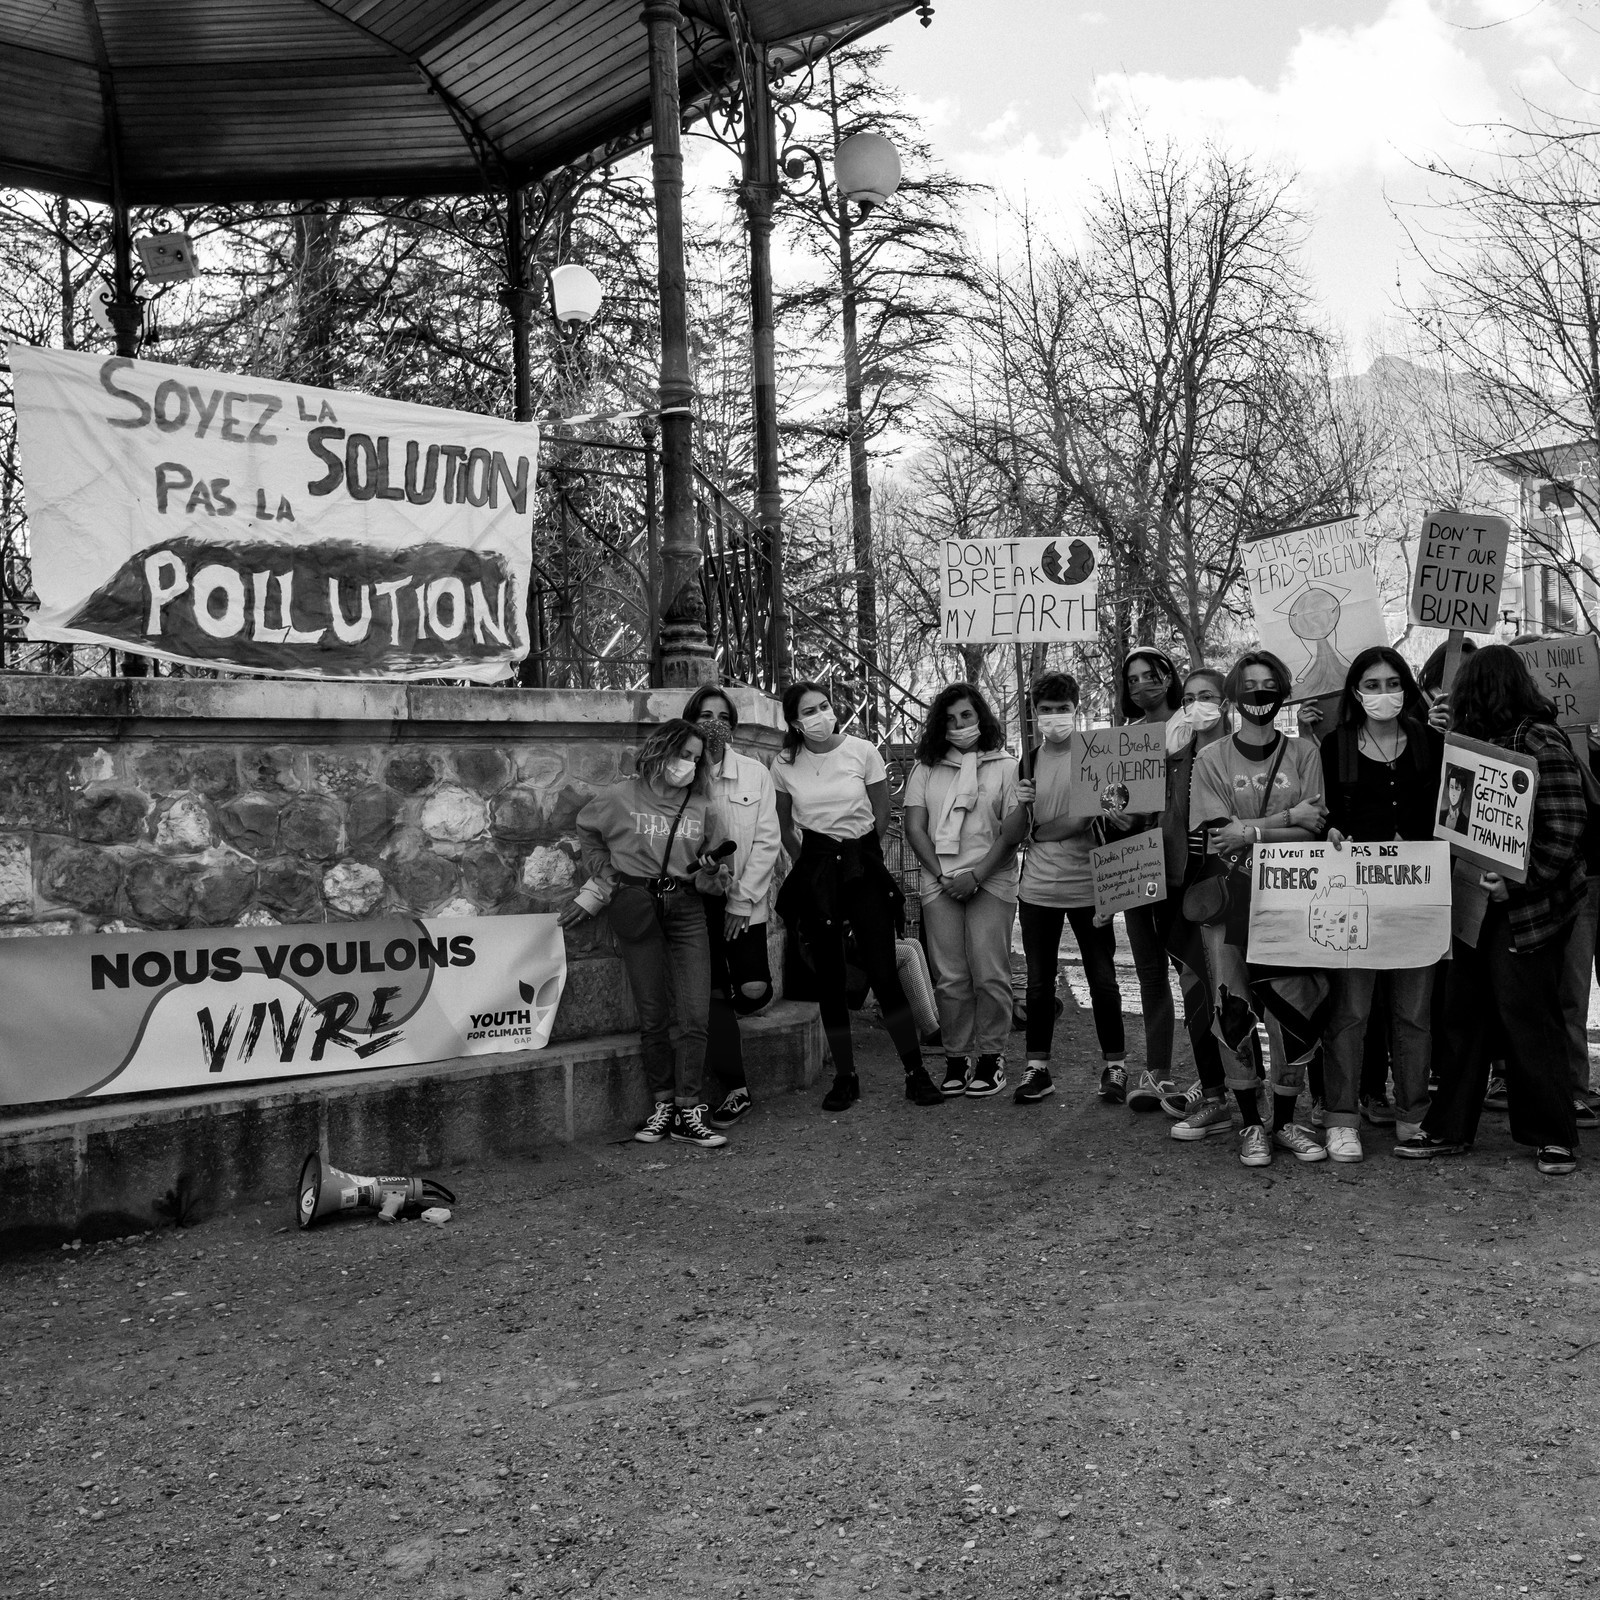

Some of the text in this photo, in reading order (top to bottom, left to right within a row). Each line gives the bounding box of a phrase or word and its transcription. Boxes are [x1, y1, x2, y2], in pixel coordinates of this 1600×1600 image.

[100, 357, 338, 445] SOYEZ LA
[155, 462, 295, 522] PAS LA
[1429, 522, 1487, 544] DON'T
[946, 541, 1020, 568] DON'T
[1426, 542, 1497, 565] LET OUR
[947, 566, 1044, 598] BREAK
[1245, 562, 1295, 596] PERD
[1420, 565, 1497, 595] FUTUR
[144, 550, 512, 648] POLLUTION
[1420, 594, 1489, 627] BURN
[946, 593, 1098, 639] MY EARTH
[1545, 672, 1572, 689] SA
[1080, 732, 1161, 764] You Broke
[1081, 758, 1166, 792] My (H)EARTH
[1479, 764, 1509, 789] IT'S
[1476, 802, 1524, 831] HOTTER
[1121, 844, 1144, 863] pour
[1148, 837, 1158, 849] le
[1351, 845, 1399, 857] PAS DES
[1472, 824, 1502, 849] THAN
[1259, 848, 1325, 860] ON VEUT DES
[1128, 874, 1136, 883] de
[1258, 862, 1319, 891] ICEBERG
[91, 935, 476, 991] NOUS VOULONS
[196, 986, 406, 1073] VIVRE
[466, 1026, 532, 1041] FOR CLIMATE
[469, 1009, 531, 1029] YOUTH
[513, 1037, 532, 1045] GAP
